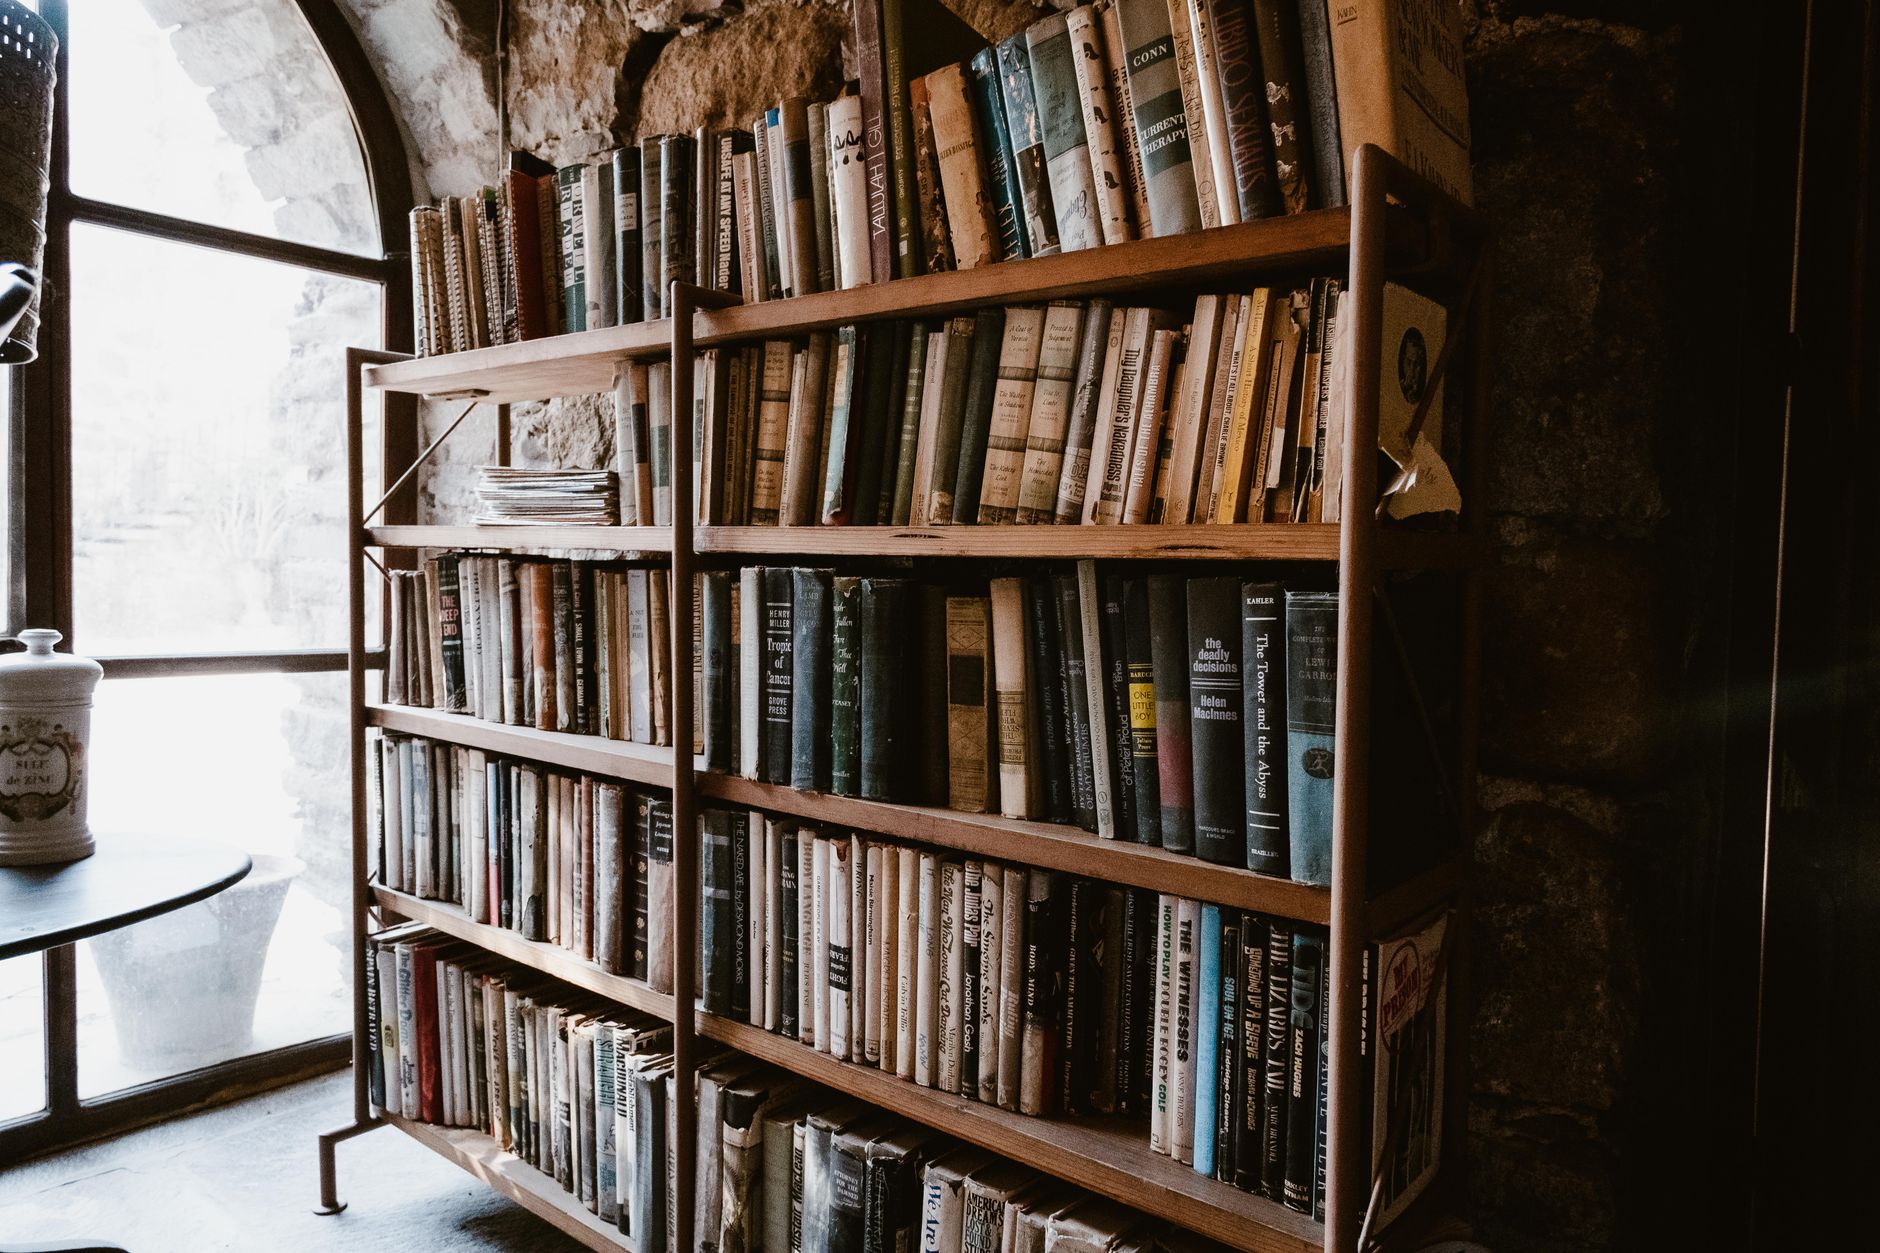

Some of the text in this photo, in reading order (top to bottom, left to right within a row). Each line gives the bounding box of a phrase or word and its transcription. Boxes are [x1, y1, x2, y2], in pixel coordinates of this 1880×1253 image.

[1133, 43, 1168, 67] CONN
[1139, 113, 1186, 141] CURRENT
[1214, 6, 1266, 192] LIBIDO SEXUALIS
[1114, 85, 1138, 194] ASTRAL PROJECTION
[1143, 128, 1187, 156] THERAPY
[867, 110, 886, 240] TALLULAH GILL
[560, 185, 574, 287] READER
[572, 184, 587, 283] ORWELL
[718, 137, 732, 289] UNSAFE AT ANY SPEED Nader
[1234, 299, 1266, 453] McHenry Short History Mexico
[1316, 317, 1335, 471] WASHINGTON WHISPERS MURDER Ford
[1106, 348, 1141, 482] Thy Daughter's Nakedness
[1132, 364, 1161, 488] TALES OF THE ALHAMBRA
[1217, 351, 1241, 468] WHAT'S ALL ABOUT, CHARLIE BROWN?
[1256, 446, 1267, 489] CLASSICAL
[440, 608, 459, 621] DEEP
[441, 595, 456, 607] THE
[769, 610, 790, 618] HENRY
[769, 619, 790, 628] MILLER
[1246, 597, 1274, 605] KAHLER
[576, 623, 585, 707] SMALL TOWN GERMANY
[767, 638, 792, 653] Tropic
[774, 655, 785, 669] of
[1193, 661, 1238, 673] decisions
[1198, 649, 1230, 662] deadly
[1205, 638, 1221, 649] the
[766, 671, 792, 685] Cancer
[768, 696, 788, 706] GROVE
[1057, 650, 1072, 745] Write Murder Down
[1132, 702, 1154, 710] LITTLE
[1134, 691, 1152, 699] ONE
[1201, 695, 1227, 708] Helen
[768, 706, 788, 715] PRESS
[1134, 712, 1152, 720] BOY
[1194, 706, 1238, 721] MacInnes
[1256, 634, 1271, 799] The Tower and the Abyss
[1071, 712, 1083, 767] PRICKING
[1080, 723, 1092, 792] MY THUMBS
[1119, 714, 1133, 786] of Peter Proud
[735, 819, 745, 984] THE NAKED APE by DESMOND MORRIS
[803, 841, 812, 956] BODY LANGUAGE
[855, 861, 863, 897] WRONG
[963, 866, 982, 947] The Judas Pair
[1006, 888, 1017, 947] REGINALD
[829, 972, 848, 985] FIGHT
[938, 867, 954, 1055] The Man Who Loved Cat Dancing
[979, 898, 994, 1025] The Singing Sands
[366, 949, 378, 1052] SPAIN BETRAYED
[399, 952, 413, 1047] The Glitter Dome
[882, 984, 890, 1028] HESITATES
[901, 975, 909, 1005] Calvin
[963, 972, 975, 1053] Jonathan Gash
[1004, 990, 1019, 1038] Ruling
[1026, 977, 1036, 1006] MIND
[1158, 905, 1172, 1113] HOW TO PLAY DOUBLE BOGEY GOLF
[1265, 930, 1289, 1096] THE LIZARD'S TAIL
[948, 1026, 956, 1058] Marilyn
[1123, 993, 1132, 1052] CIVILIZATION
[1177, 919, 1192, 1129] THE WITNESSES ANNE HOLDEN
[1244, 946, 1263, 1131] SOMETHING UP SLEEVE RICHARD LOCKRIDGE
[596, 1038, 615, 1111] STRAIGHT
[1144, 1025, 1155, 1080] UNIVERSE
[1222, 976, 1235, 1133] SOUL ON ICE Eldridge Cleaver
[1292, 1028, 1304, 1099] ZACH HUGHES
[626, 1068, 636, 1132] Establishment
[1316, 990, 1330, 1192] Grownups ANNE TYLER
[791, 1147, 803, 1204] MacLean
[837, 1186, 859, 1201] DAMNED
[847, 1182, 859, 1192] THE
[926, 1183, 941, 1245] We Are
[964, 1232, 992, 1249] FOUND
[965, 1205, 1004, 1226] DREAMS
[966, 1219, 992, 1236] LOST &
